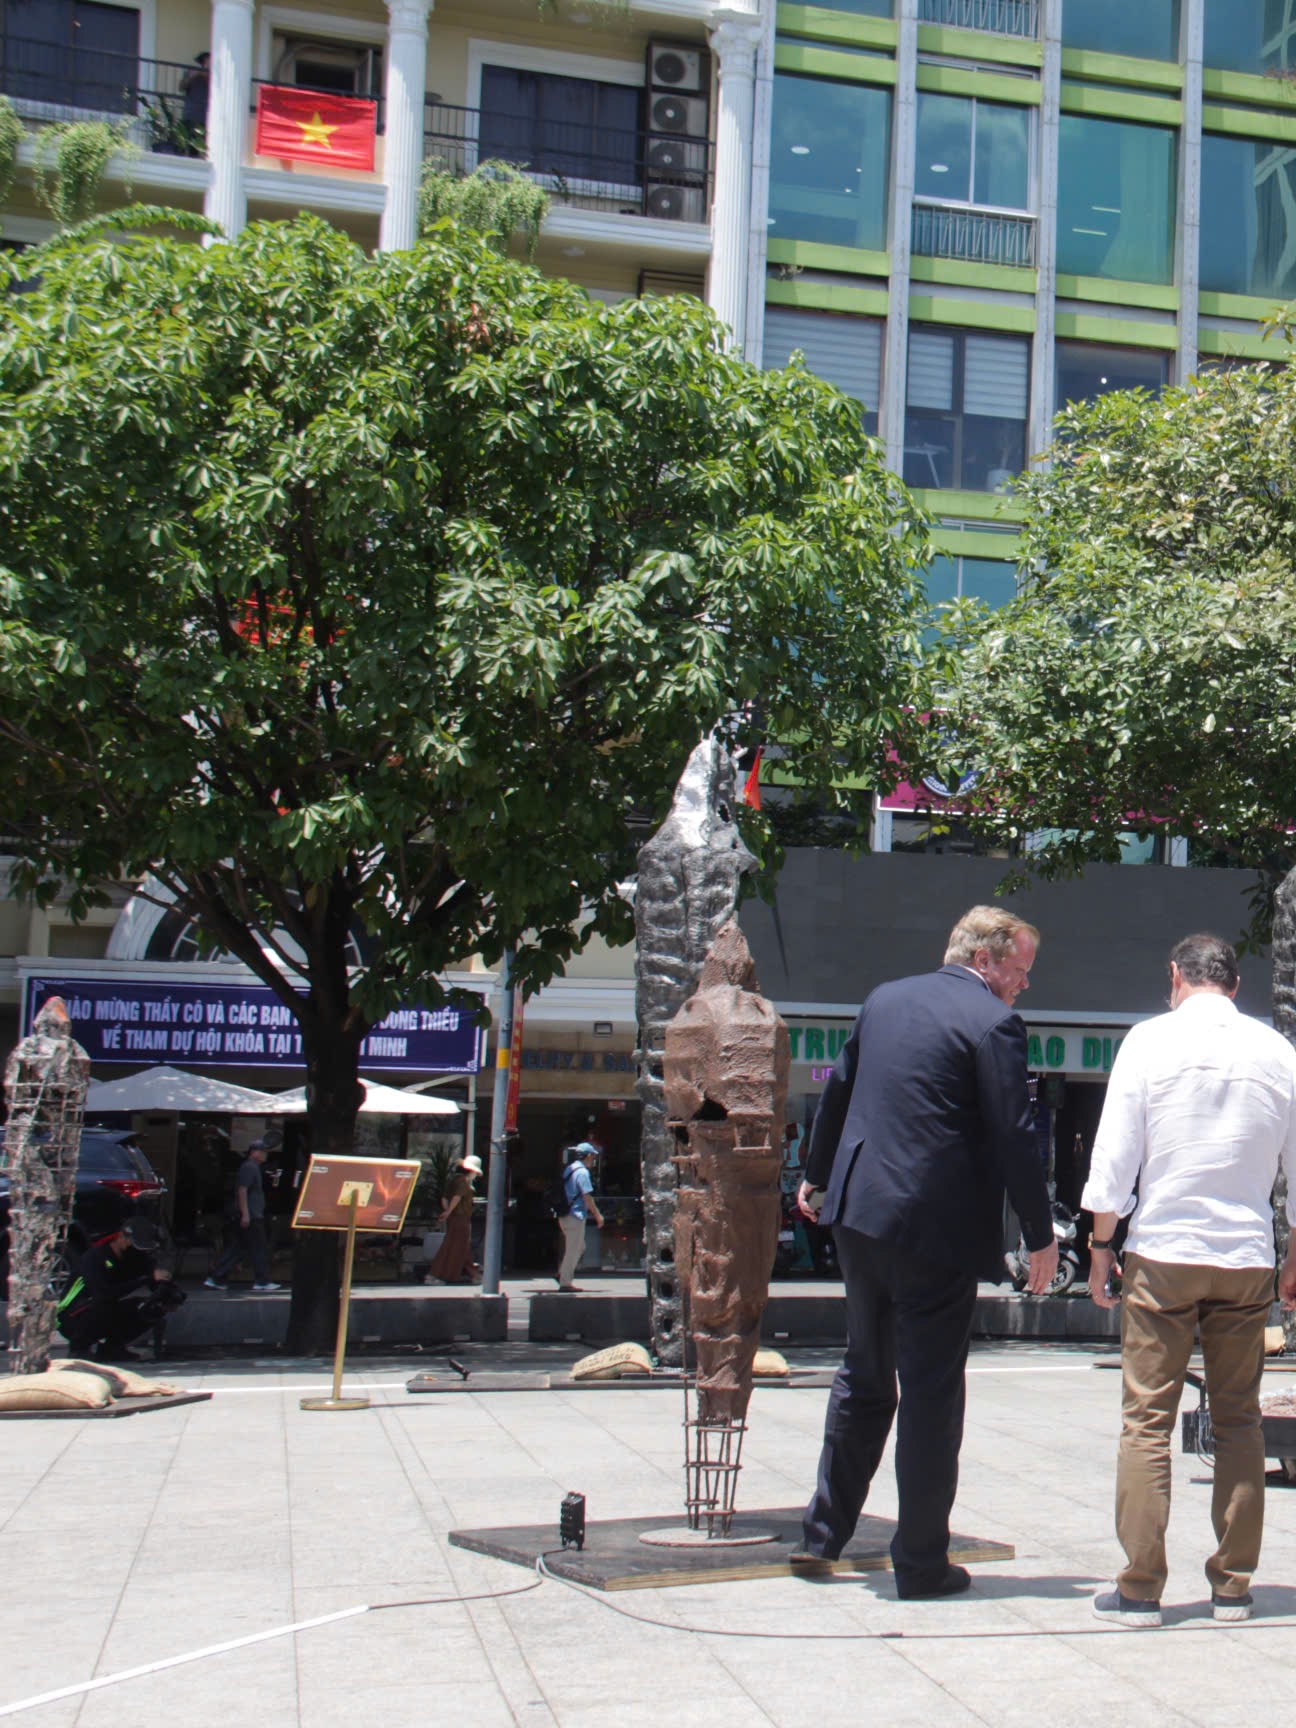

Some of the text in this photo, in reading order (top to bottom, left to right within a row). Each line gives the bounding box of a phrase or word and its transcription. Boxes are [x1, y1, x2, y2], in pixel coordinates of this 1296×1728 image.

[182, 1000, 203, 1023] CÔ
[206, 1000, 225, 1024] VÀ
[228, 1001, 258, 1025] CÁC
[260, 1005, 291, 1030] BẠN
[125, 1029, 168, 1050] THAM
[196, 1028, 221, 1056] HỘI
[224, 1029, 265, 1053] KHÓA
[268, 1033, 292, 1058] TẠI
[368, 1036, 407, 1057] MINH
